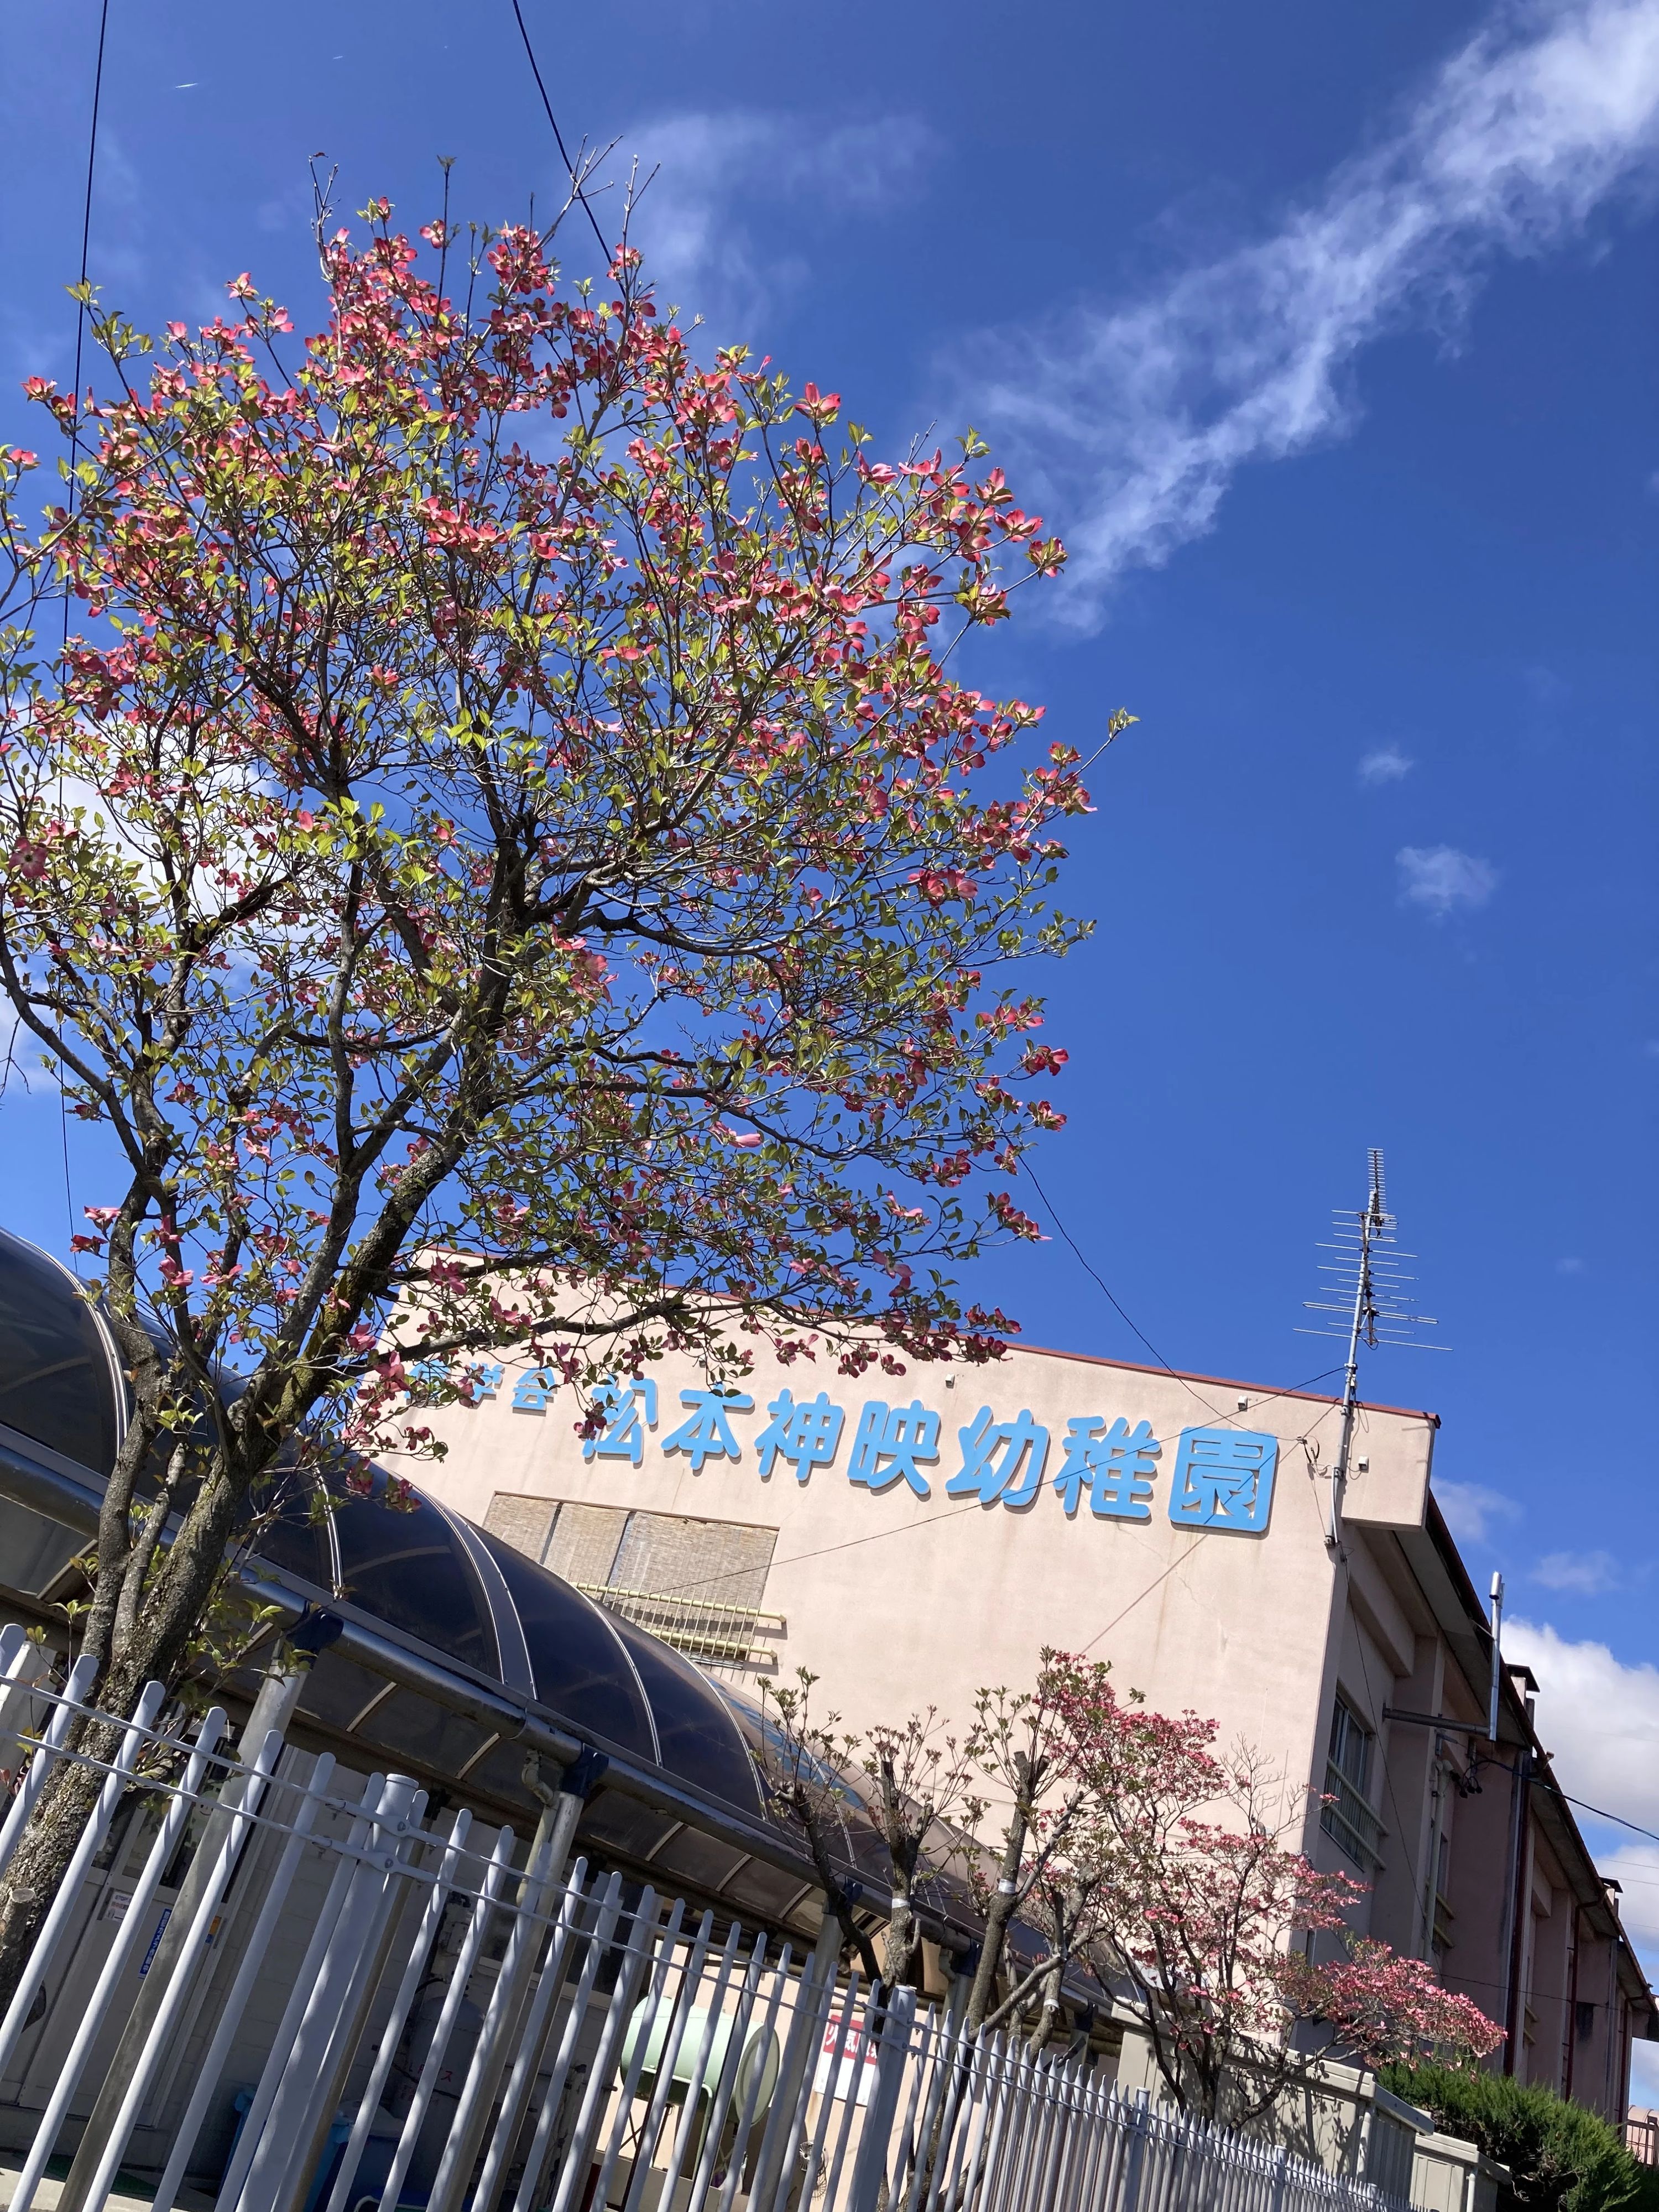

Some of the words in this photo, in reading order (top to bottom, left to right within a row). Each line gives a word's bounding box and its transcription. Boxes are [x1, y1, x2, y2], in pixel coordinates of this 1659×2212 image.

[582, 1375, 1277, 1532] 松本神映幼稚園
